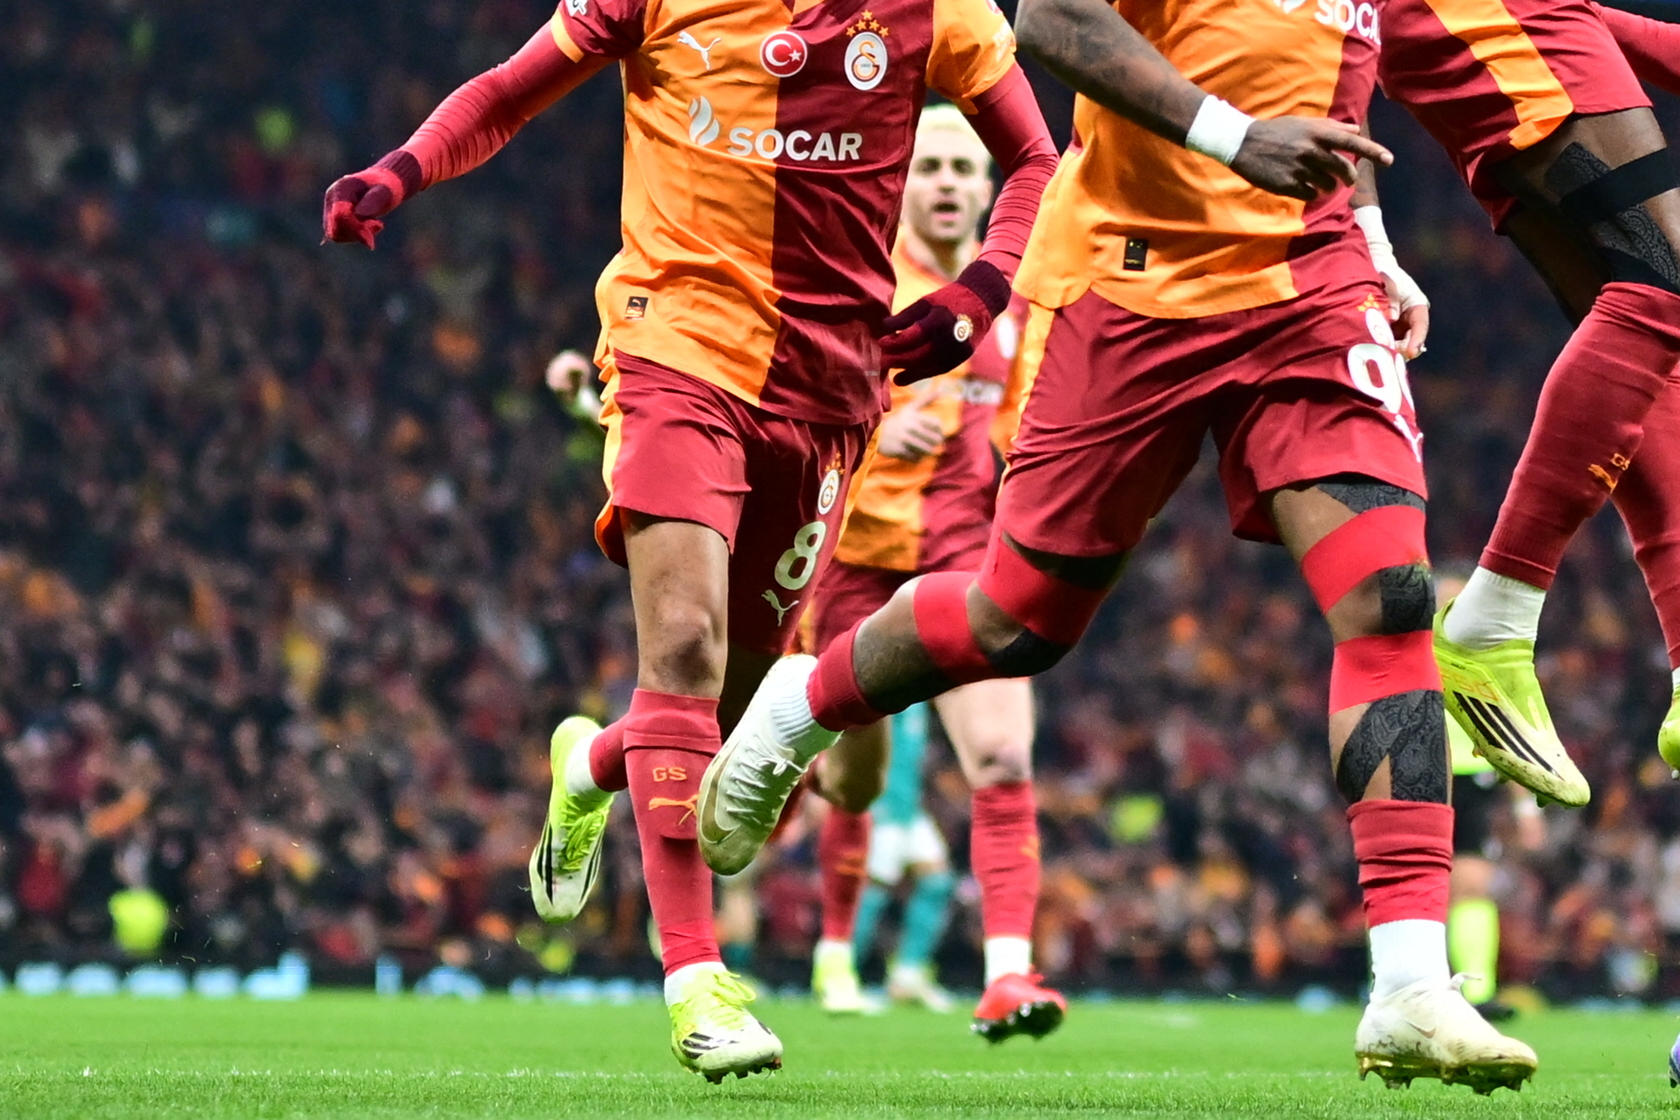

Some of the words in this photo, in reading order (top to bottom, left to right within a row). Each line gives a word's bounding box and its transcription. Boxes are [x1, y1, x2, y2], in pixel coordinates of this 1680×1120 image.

[727, 126, 863, 161] SOCAR
[774, 521, 827, 591] 8
[652, 767, 687, 782] GS
